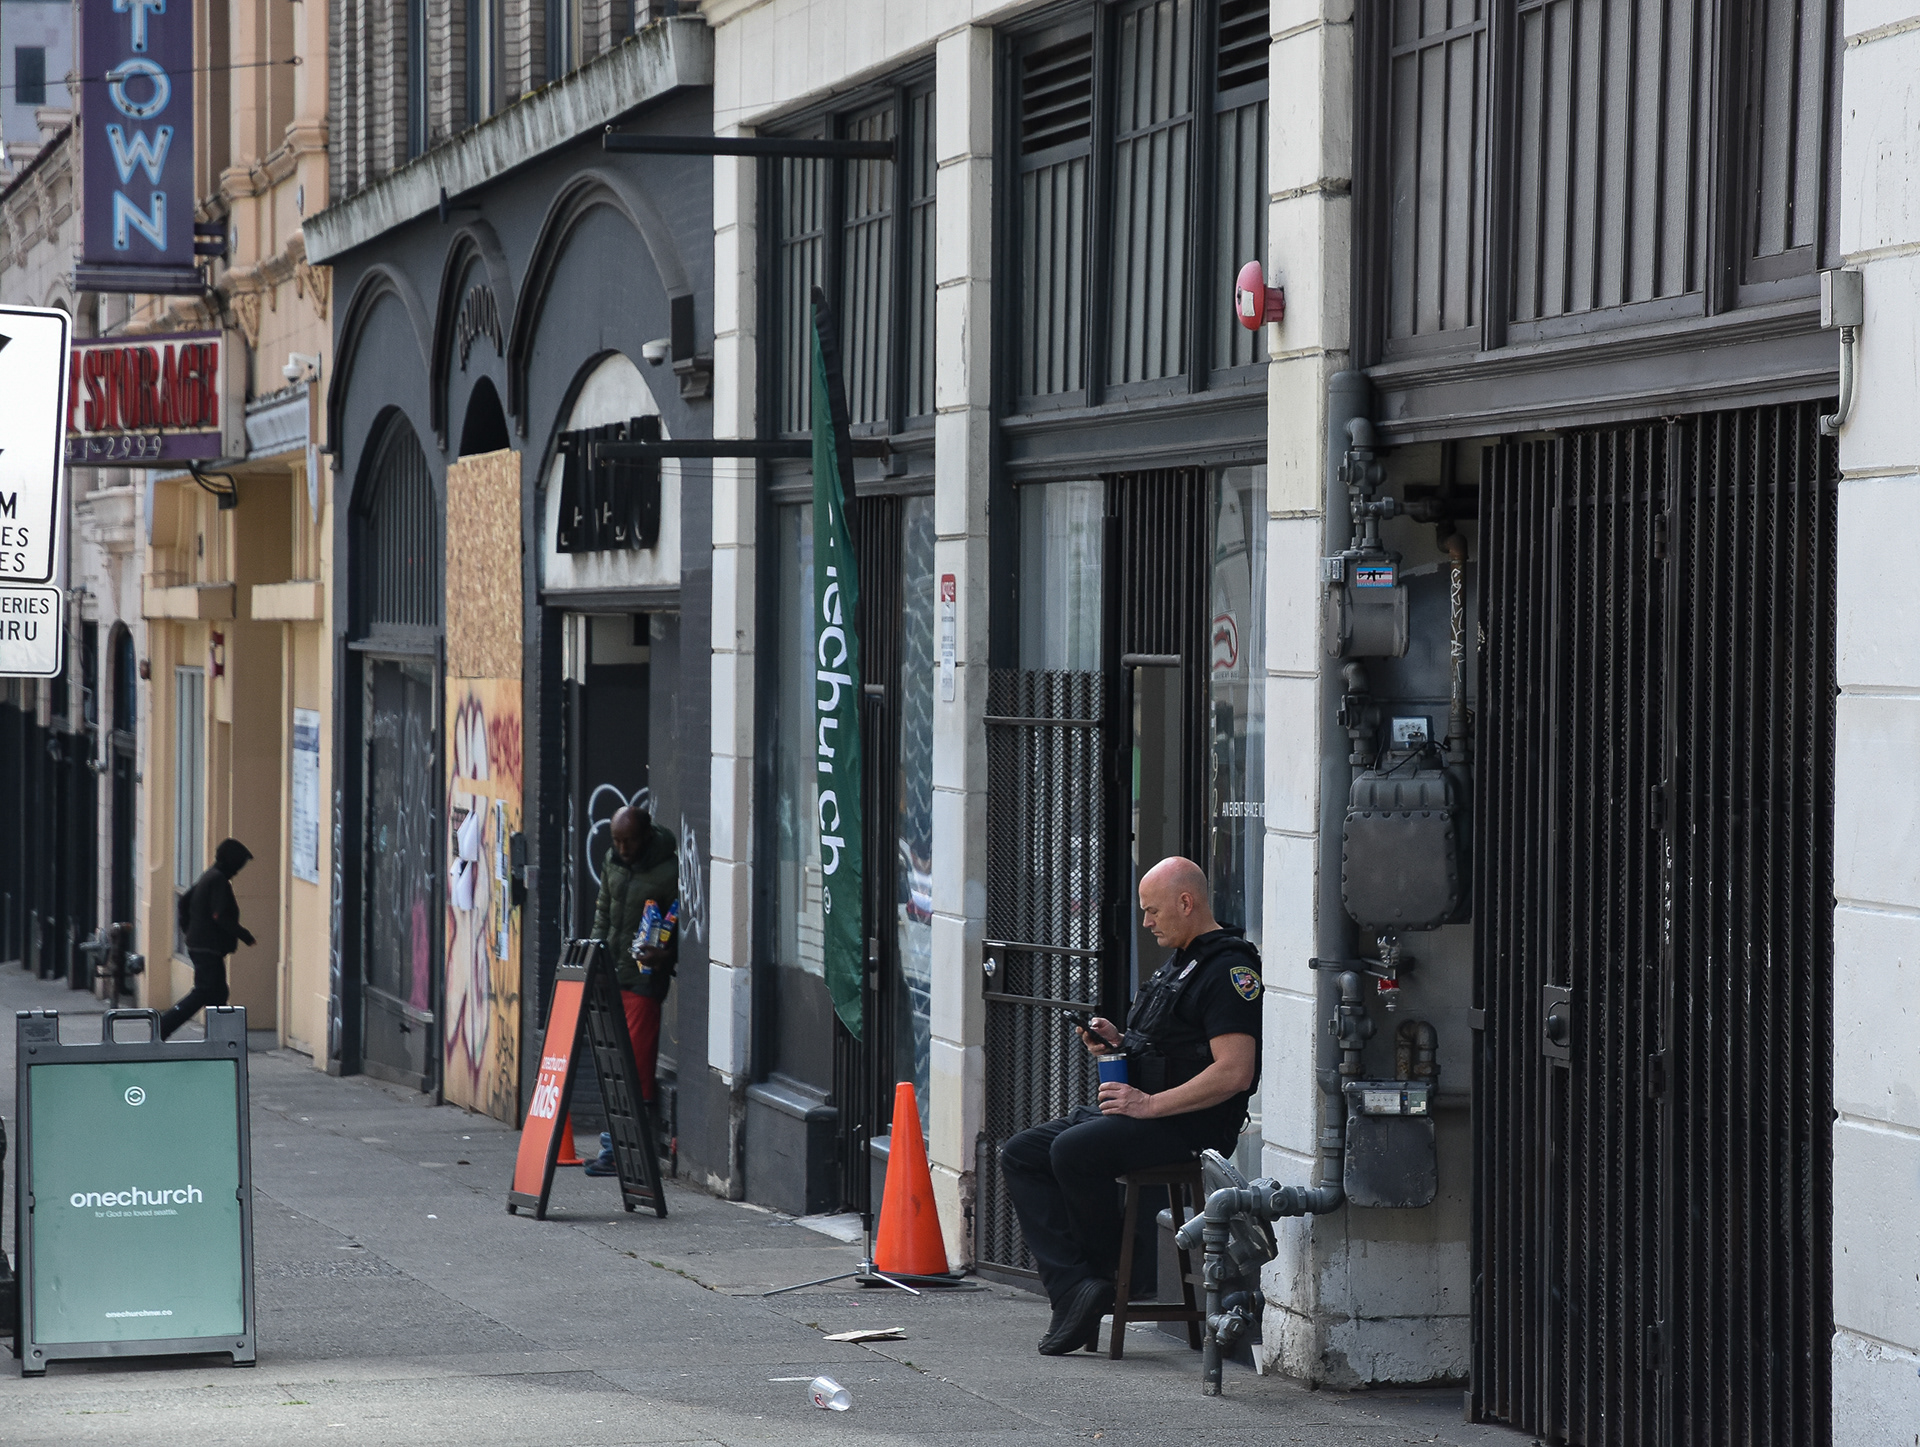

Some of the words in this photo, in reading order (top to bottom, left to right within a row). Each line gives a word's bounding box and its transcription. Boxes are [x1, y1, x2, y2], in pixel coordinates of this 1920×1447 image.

[106, 0, 174, 251] TOWN
[83, 342, 218, 432] STORAGE
[0, 490, 17, 519] M
[0, 597, 49, 615] ERIES
[1229, 801, 1244, 817] EVENT
[1244, 801, 1258, 817] SPACE
[530, 1072, 560, 1120] kids
[69, 1184, 203, 1208] onechurch
[106, 1210, 122, 1218] God
[133, 1209, 153, 1217] loved
